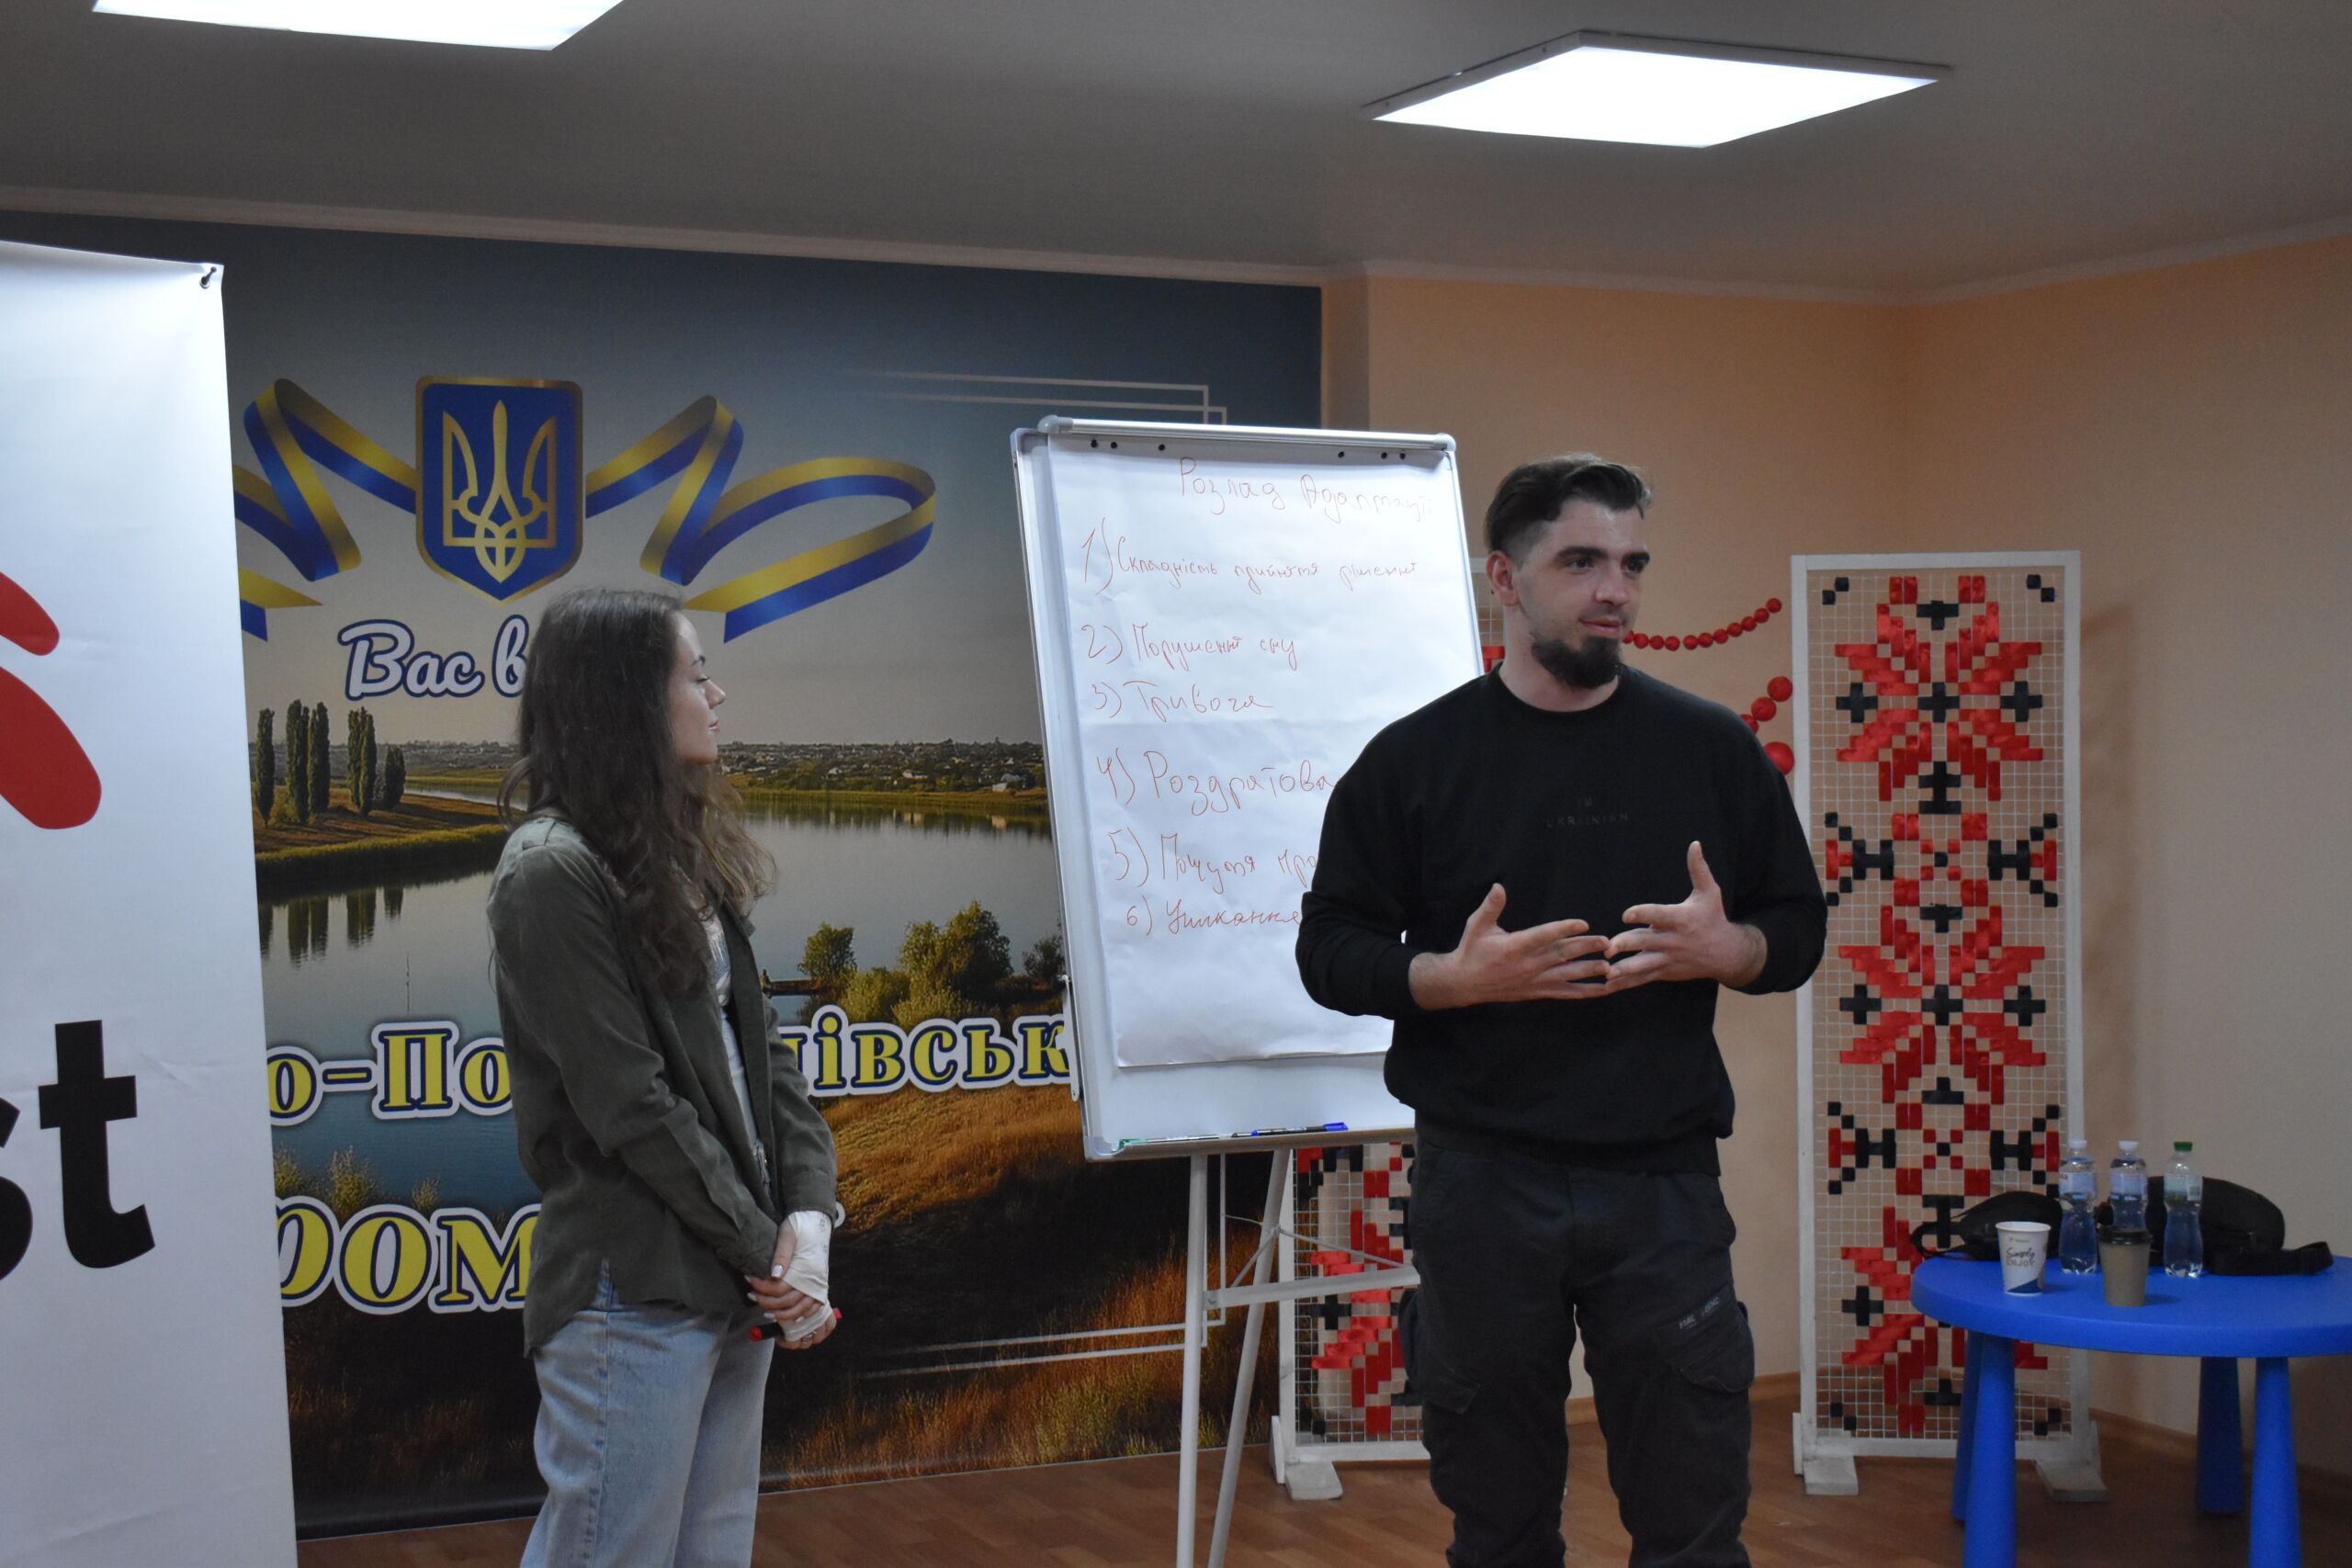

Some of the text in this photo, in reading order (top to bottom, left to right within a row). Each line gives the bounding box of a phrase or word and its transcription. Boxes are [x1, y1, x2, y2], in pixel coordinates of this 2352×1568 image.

[1181, 457, 1285, 515] Розлад
[1081, 517, 1113, 595] 1)
[1117, 536, 1218, 589] Складність
[338, 619, 485, 701] Вас
[1081, 625, 1123, 664] 2)
[1260, 638, 1297, 671] сну
[1091, 681, 1274, 723] 3) Тривога
[1097, 748, 1135, 806] 4)
[1108, 827, 1148, 887] 5)
[1127, 895, 1152, 935] 6)
[2006, 1247, 2035, 1264] Simply
